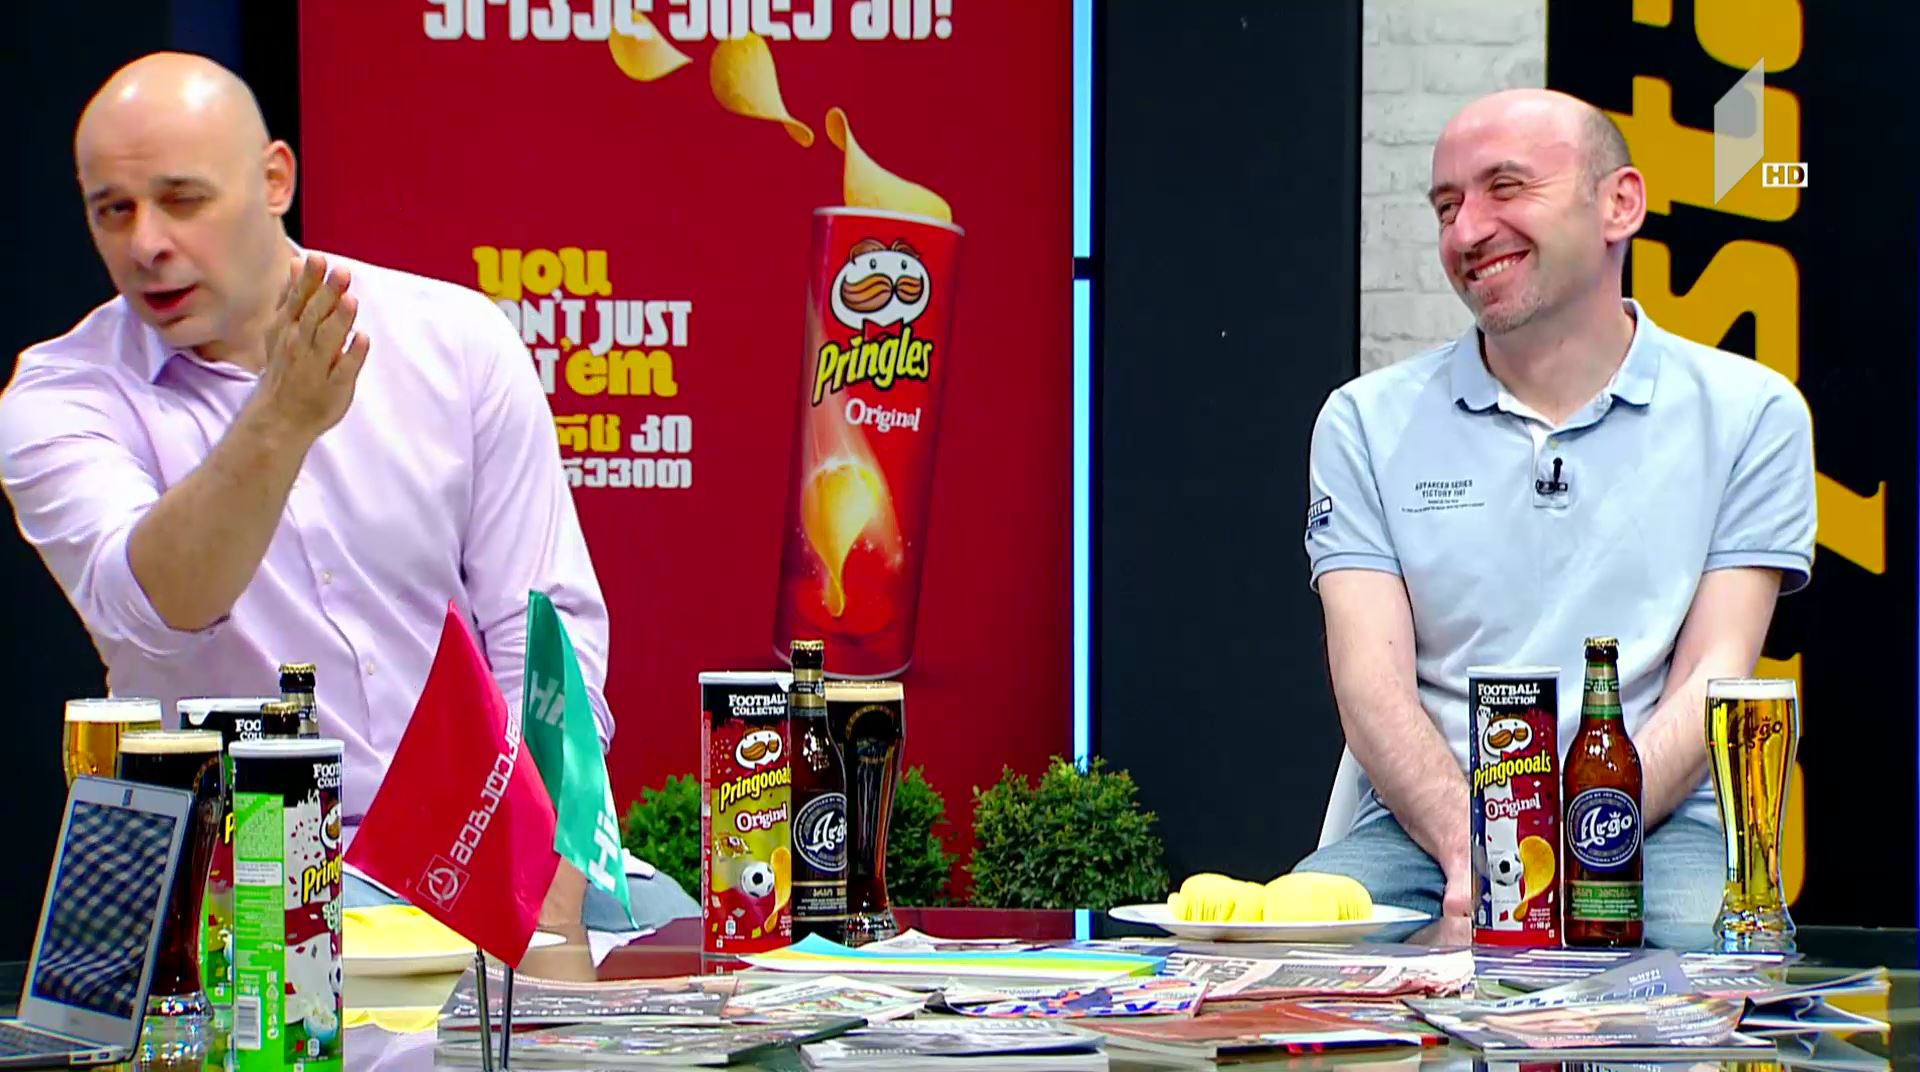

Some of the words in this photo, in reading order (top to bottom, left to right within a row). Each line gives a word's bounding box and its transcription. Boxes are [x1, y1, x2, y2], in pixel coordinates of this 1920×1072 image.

[472, 246, 613, 302] you
[588, 300, 693, 357] JUST
[811, 324, 933, 407] Pringles
[844, 397, 922, 433] Original
[728, 692, 788, 708] FOOTBALL
[1477, 682, 1541, 697] FOOTBALL
[1480, 696, 1537, 706] COLLECTION
[732, 705, 786, 717] COLLECTION
[1472, 748, 1552, 799] Pringoooals
[735, 802, 788, 832] Original
[1485, 792, 1542, 820] Original
[805, 810, 847, 853] Arg
[1576, 806, 1633, 850] Argo
